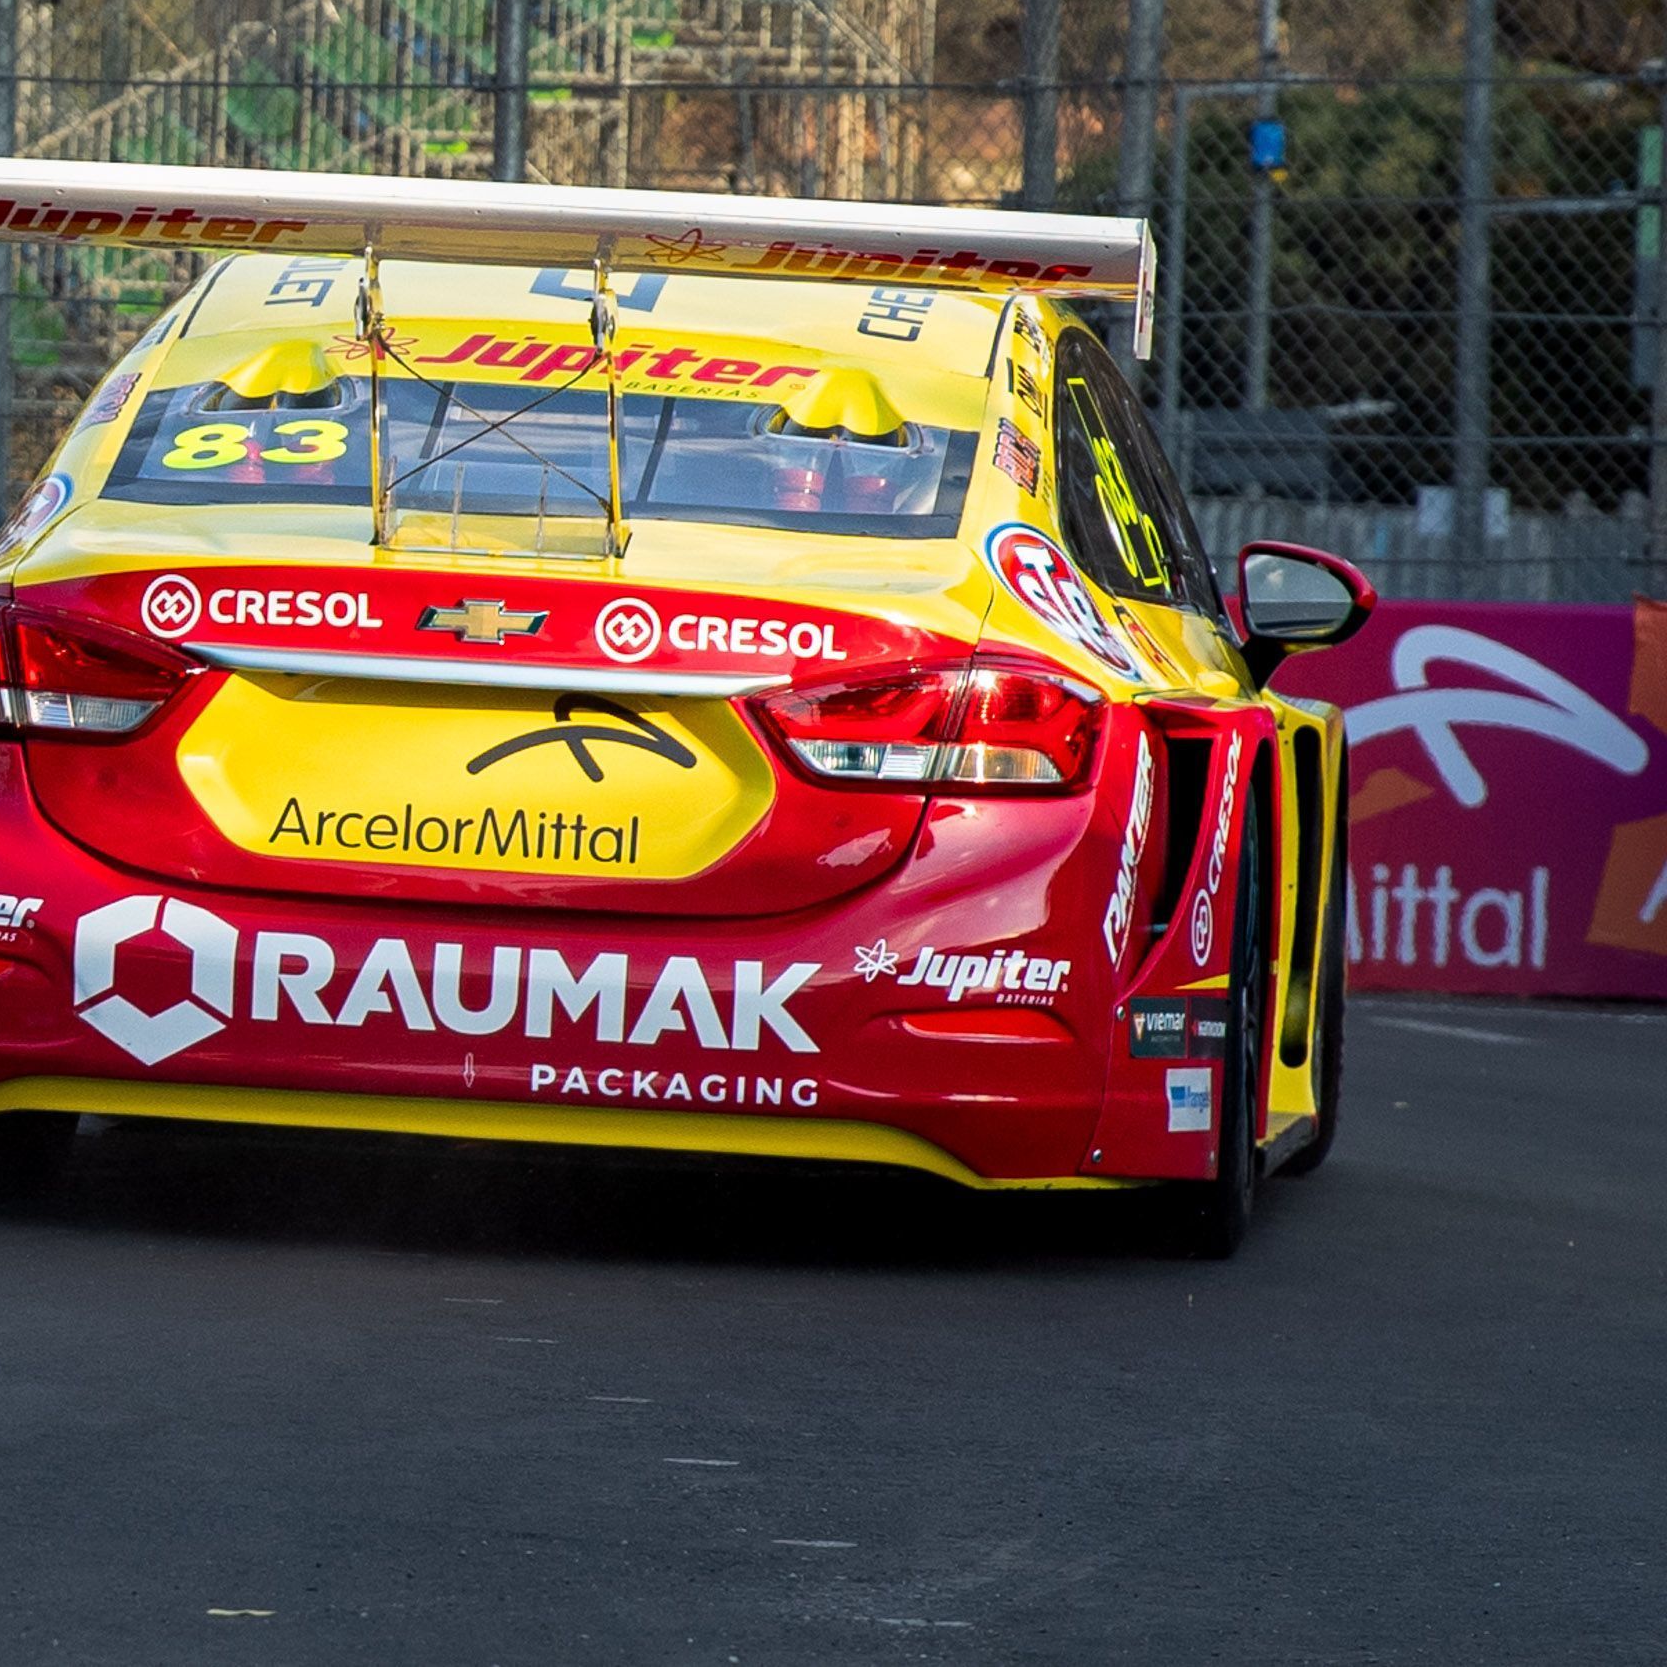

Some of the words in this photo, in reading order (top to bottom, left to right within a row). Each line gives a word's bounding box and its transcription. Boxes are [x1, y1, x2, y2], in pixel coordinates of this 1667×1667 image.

[162, 420, 348, 470] 83
[208, 589, 383, 629] CRESOL
[668, 613, 847, 661] CRESOL
[269, 797, 640, 863] ArcelorMittal
[1209, 728, 1243, 895] CRESOL
[250, 930, 823, 1054] RAUMAK
[530, 1063, 820, 1108] PACKAGING
